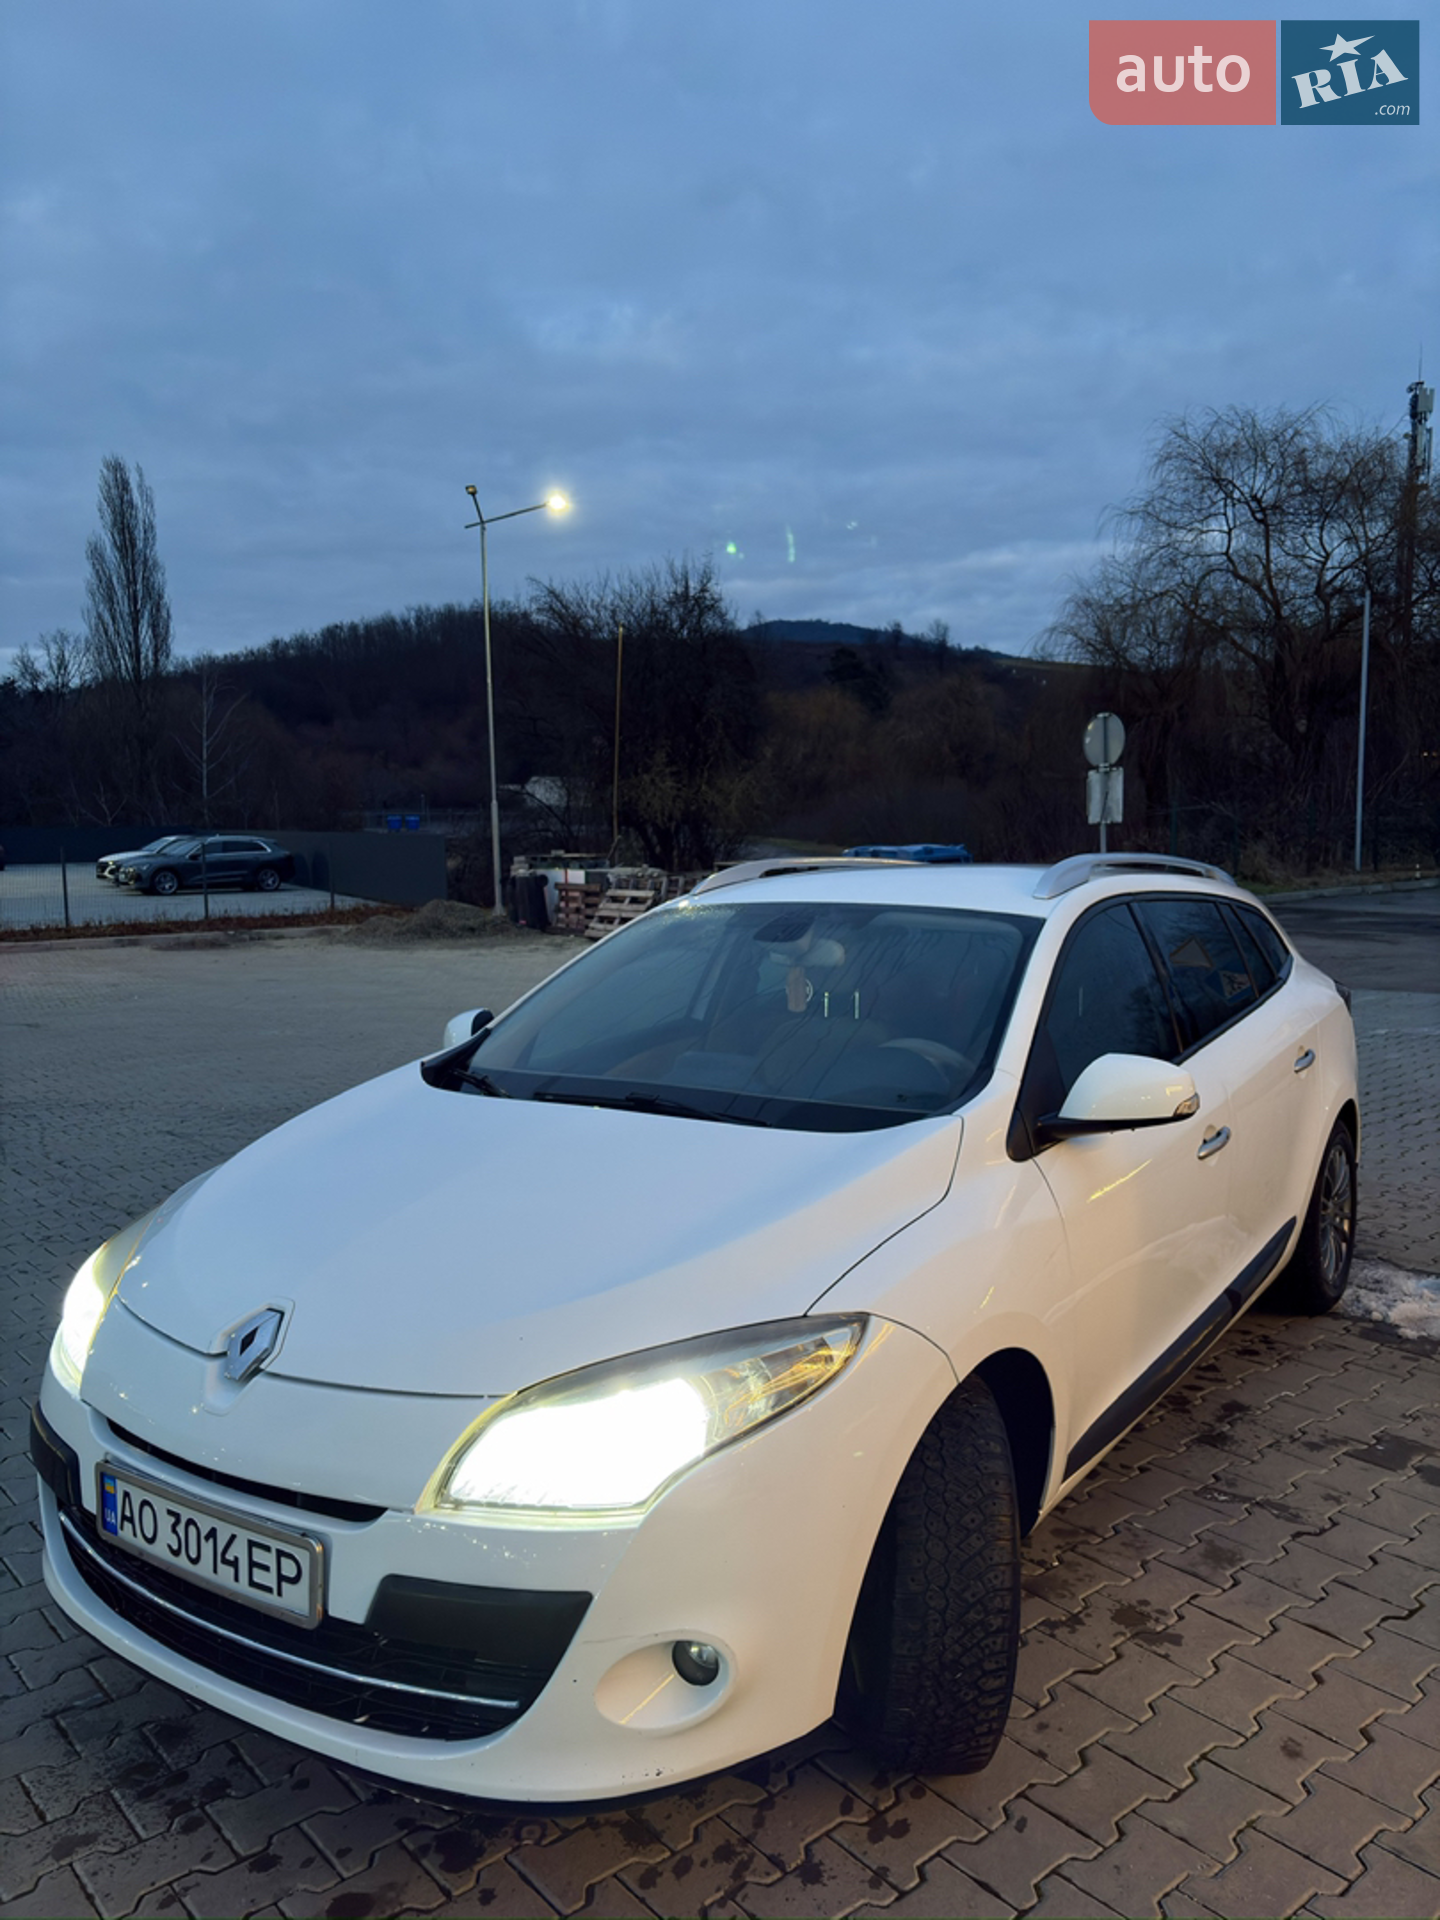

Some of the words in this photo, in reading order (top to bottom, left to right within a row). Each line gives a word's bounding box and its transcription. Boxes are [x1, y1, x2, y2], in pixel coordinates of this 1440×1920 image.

[104, 1508, 116, 1525] UA
[120, 1490, 157, 1545] AO
[166, 1509, 239, 1583] 3014
[247, 1538, 302, 1597] EP
